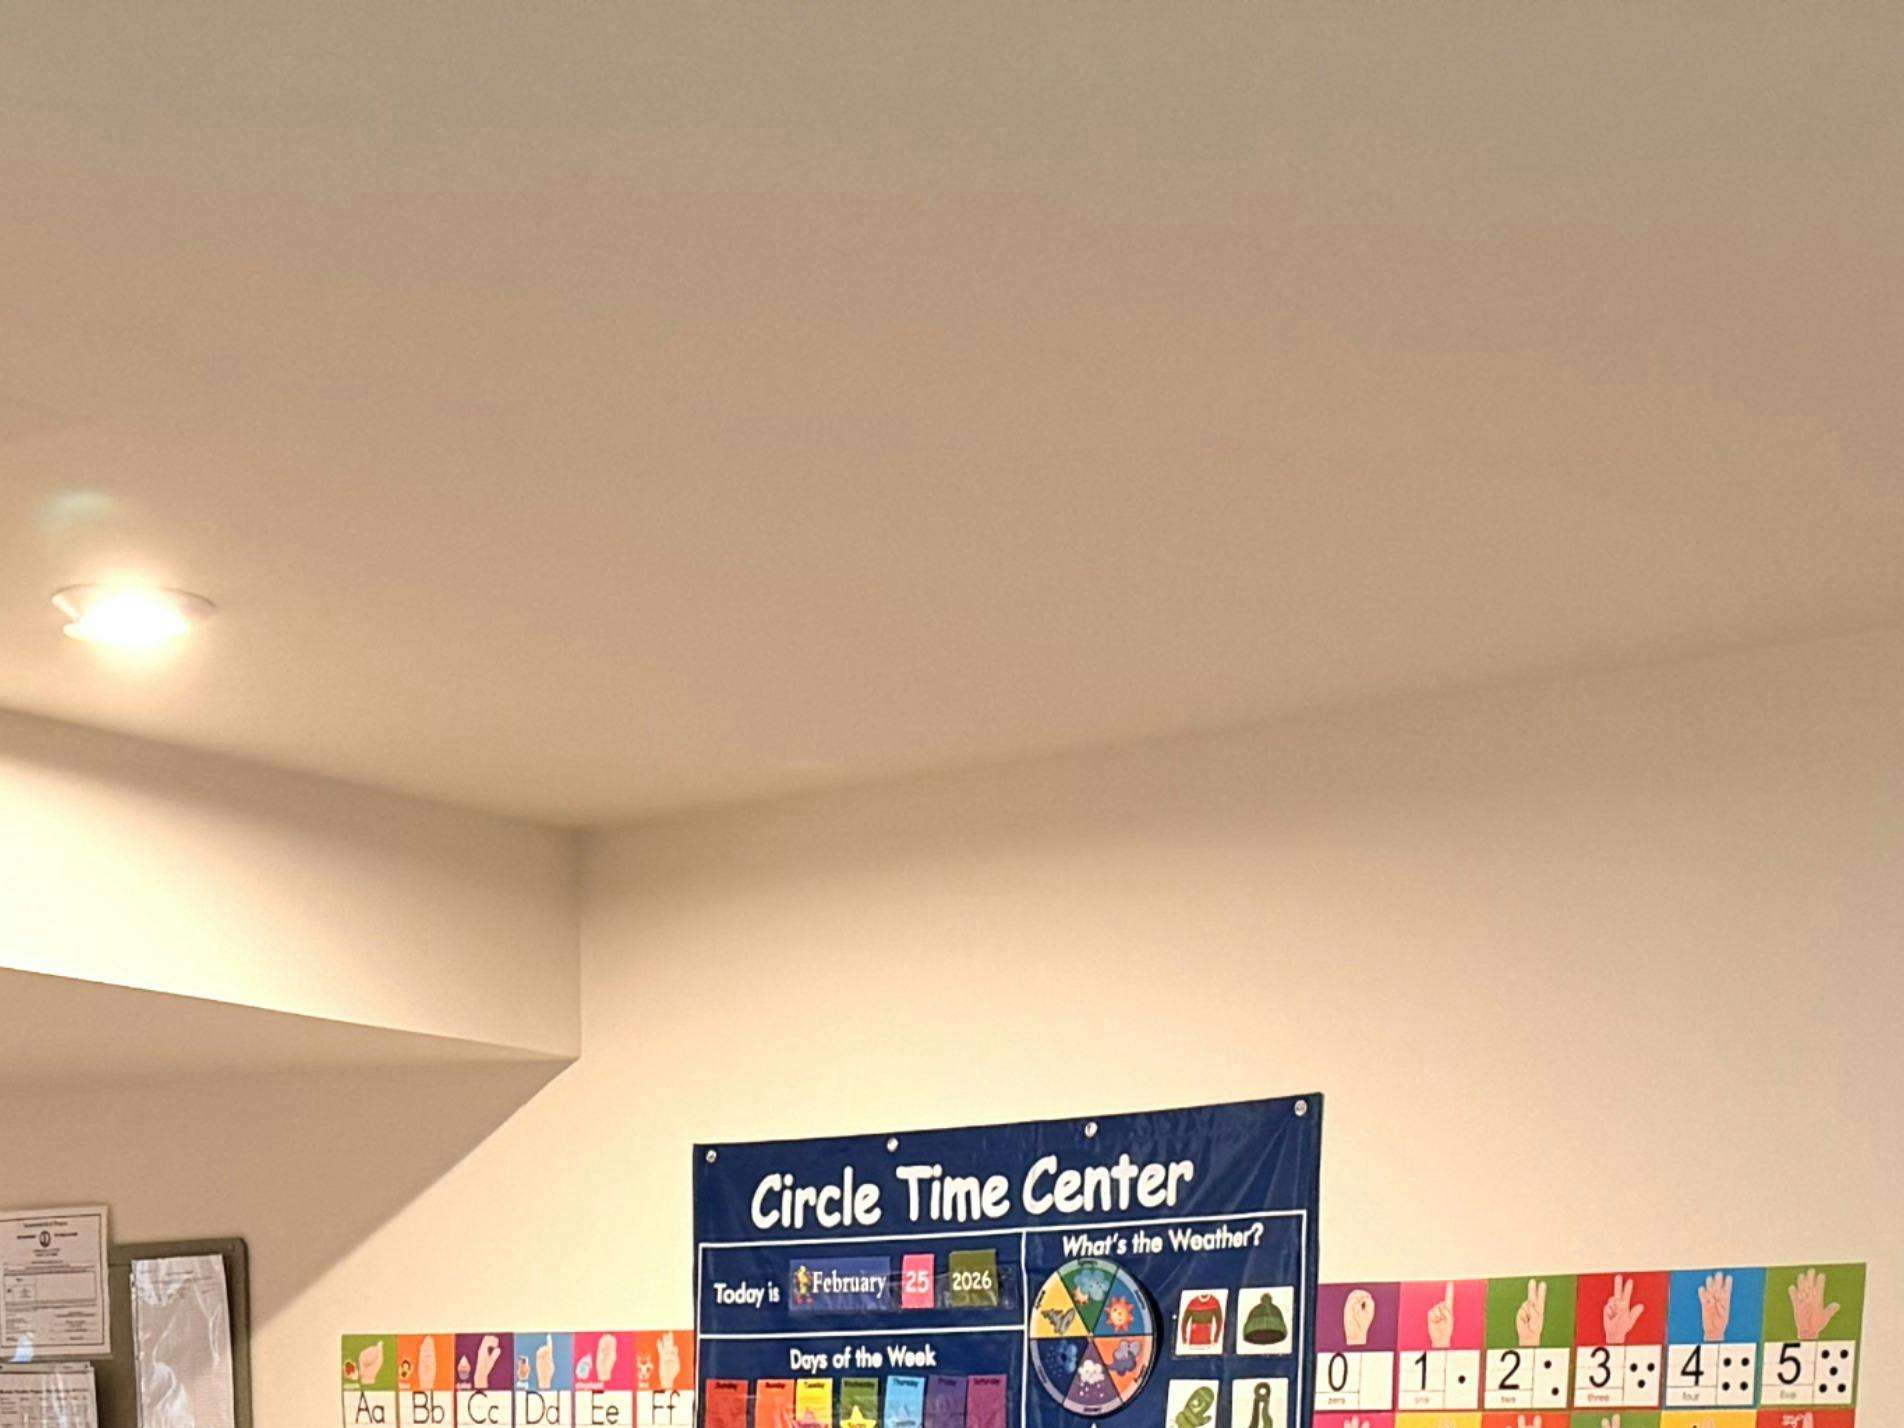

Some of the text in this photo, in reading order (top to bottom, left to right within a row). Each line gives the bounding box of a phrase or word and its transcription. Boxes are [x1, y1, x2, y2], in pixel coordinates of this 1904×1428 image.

[751, 1154, 1194, 1229] Circle Time Center
[1062, 1222, 1264, 1257] What's the Weather?
[714, 1270, 992, 1308] Today is February 25 2026
[790, 1344, 936, 1374] Days of the Week
[1327, 1352, 1348, 1392] 0
[1414, 1352, 1428, 1391] 1
[1498, 1350, 1522, 1391] 2
[1588, 1347, 1612, 1389] 3
[1680, 1345, 1705, 1387] 4
[1777, 1343, 1802, 1385] 5
[355, 1391, 386, 1426] Aa
[412, 1392, 446, 1426] Bb
[467, 1390, 500, 1426] Cc
[524, 1391, 561, 1426] Dd
[592, 1389, 621, 1426] Ee
[652, 1388, 681, 1426] Ff
